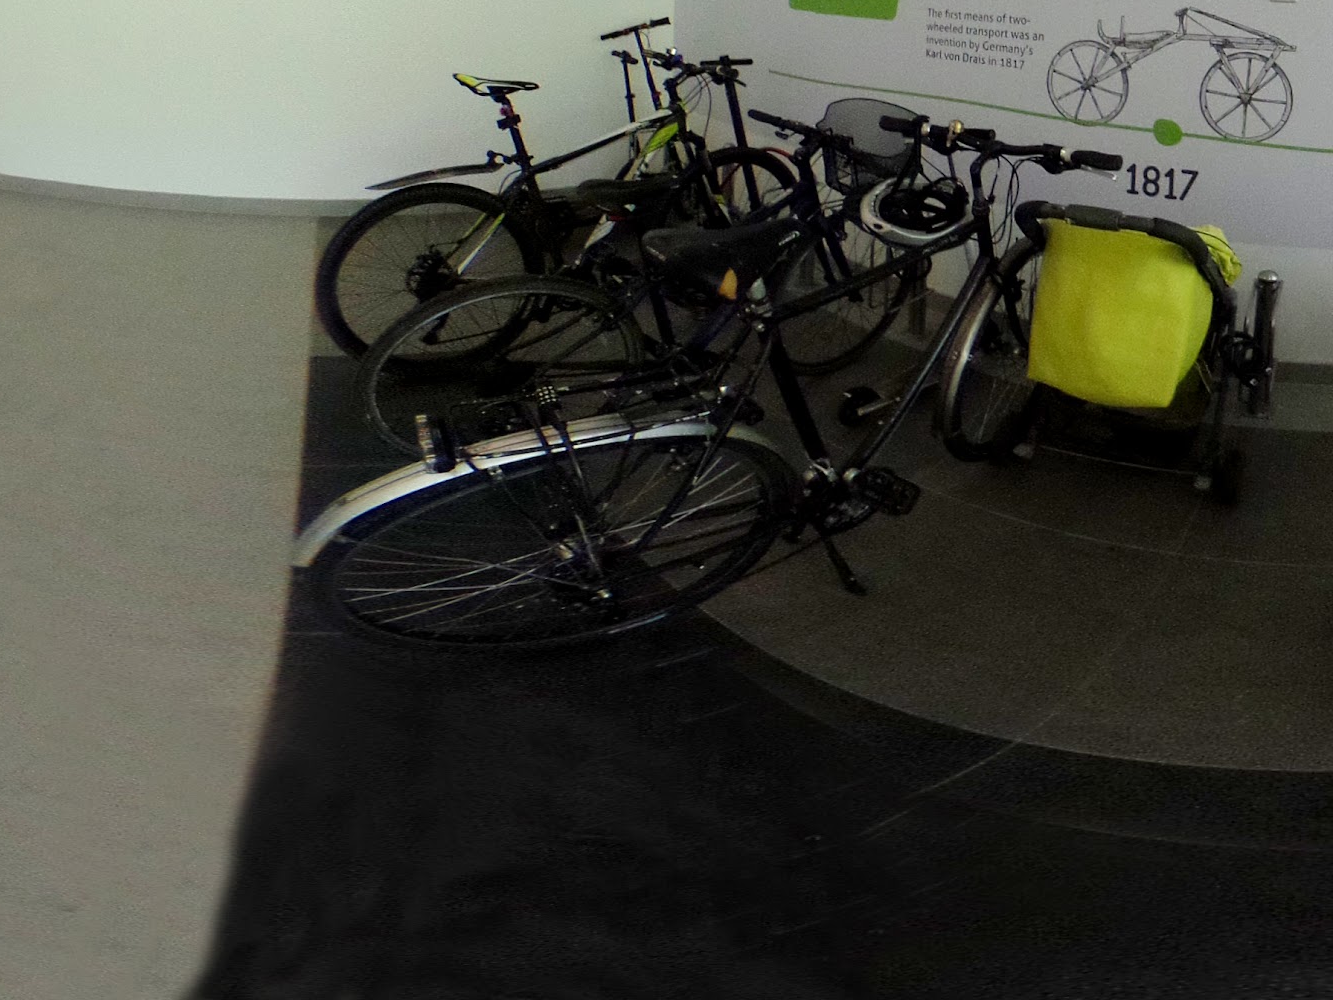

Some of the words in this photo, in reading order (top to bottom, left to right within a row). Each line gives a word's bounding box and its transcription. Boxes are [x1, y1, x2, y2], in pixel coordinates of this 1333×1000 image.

[928, 8, 942, 19] The
[945, 9, 961, 20] first
[964, 12, 993, 23] means
[996, 13, 1007, 23] of
[1009, 15, 1031, 25] two-
[926, 22, 963, 34] wheeled
[966, 26, 1008, 39] transport
[1011, 31, 1030, 40] was
[1032, 32, 1044, 41] an
[926, 35, 967, 49] invention
[969, 40, 980, 53] by
[982, 41, 1034, 57] Germany's
[925, 49, 942, 59] Karl
[944, 53, 960, 62] von
[963, 52, 985, 65] Drais
[988, 55, 997, 66] in
[1001, 58, 1025, 70] 1817
[1126, 163, 1199, 201] 1817
